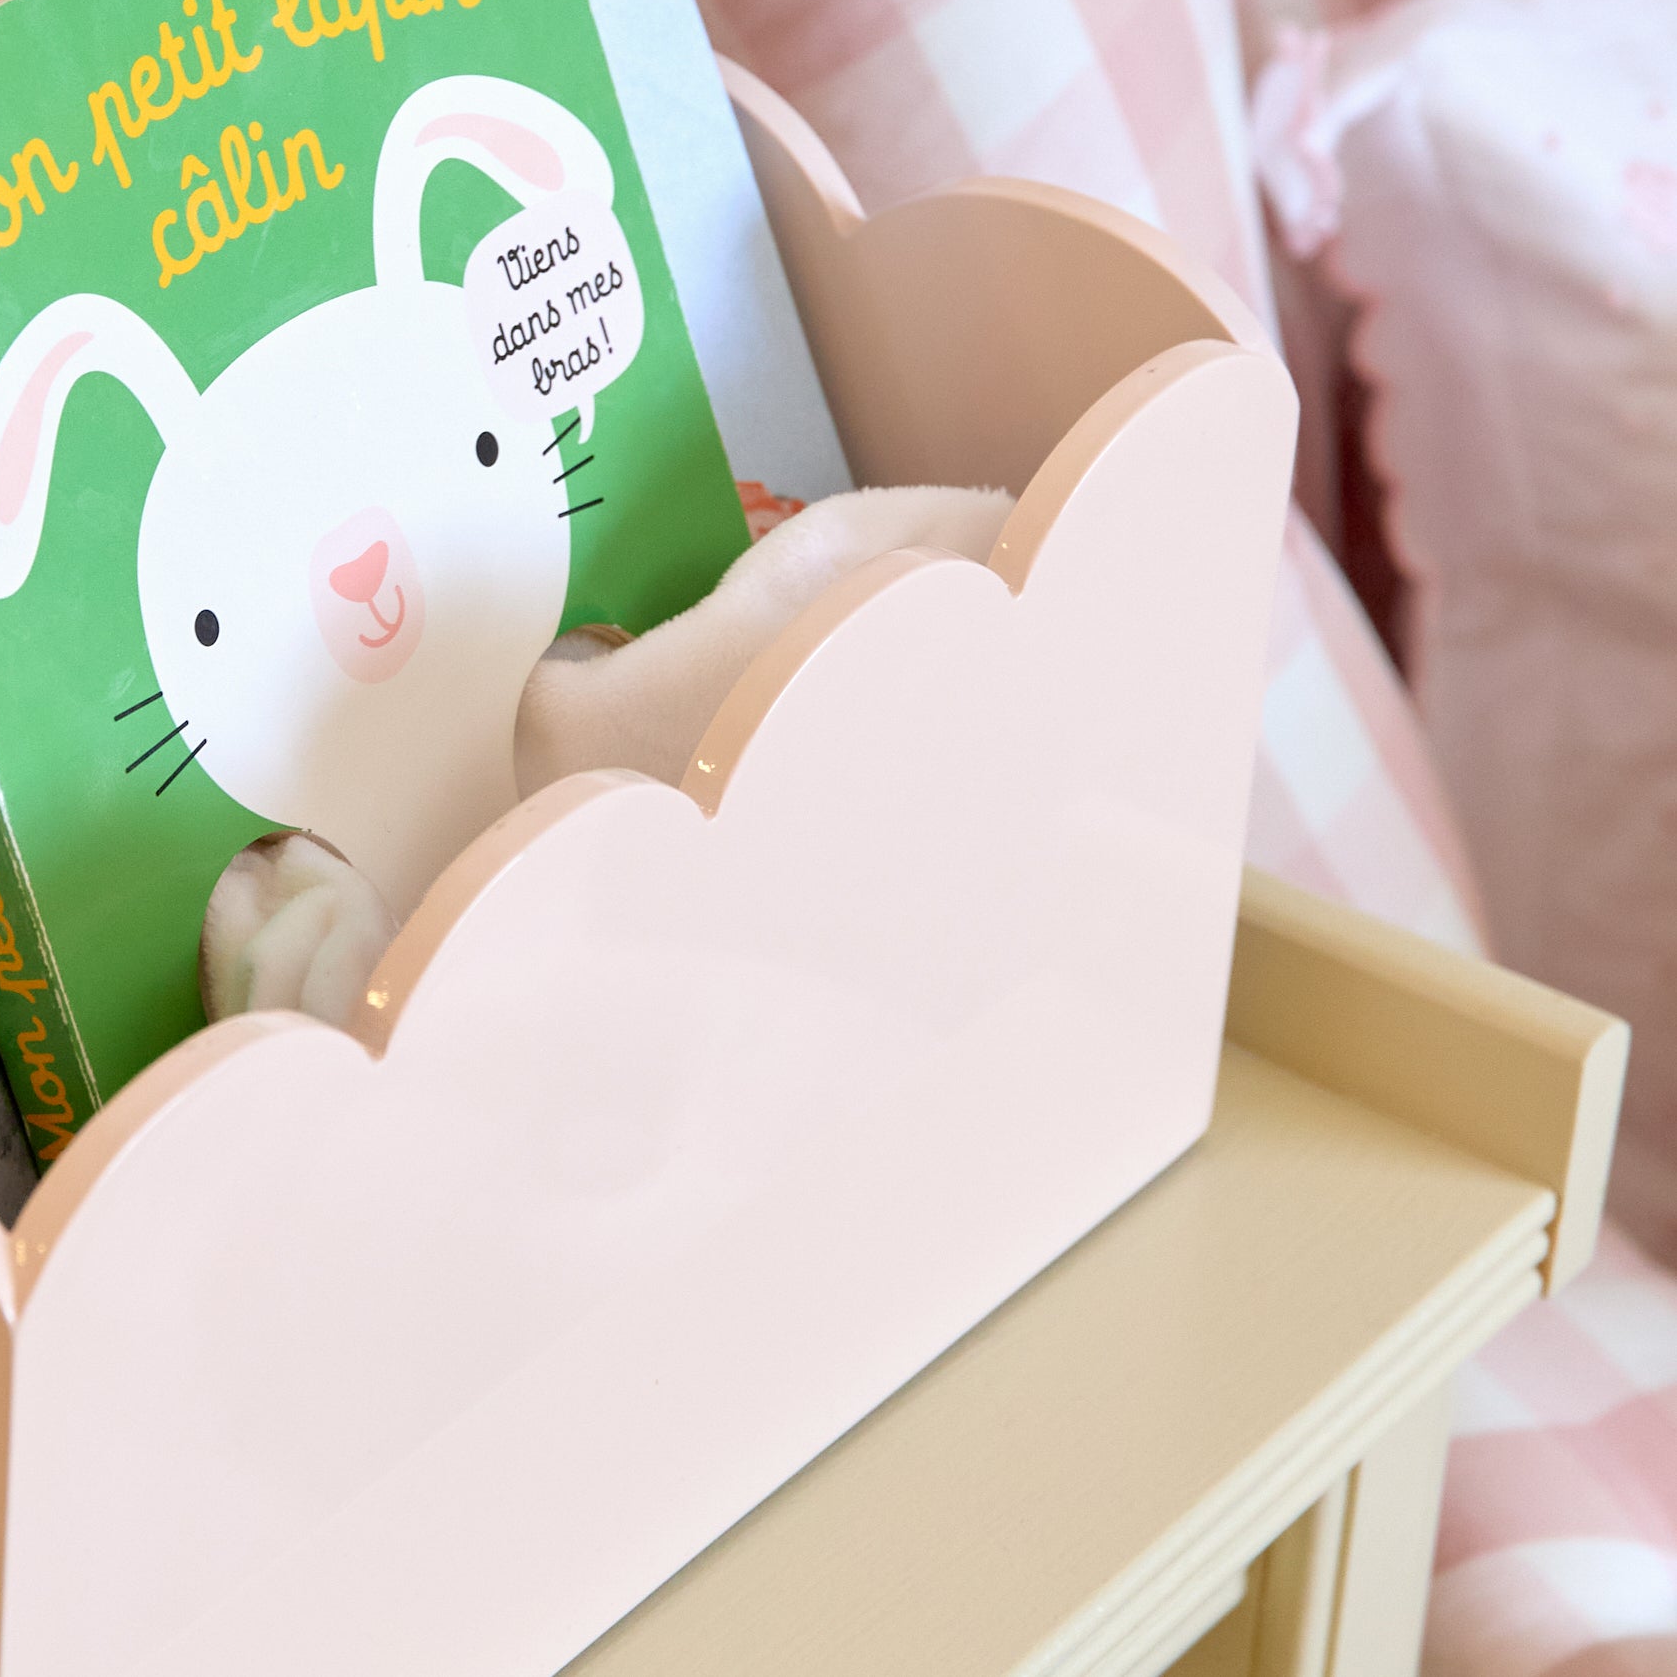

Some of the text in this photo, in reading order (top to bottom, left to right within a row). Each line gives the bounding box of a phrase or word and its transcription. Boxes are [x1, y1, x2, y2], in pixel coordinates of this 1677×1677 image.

[150, 119, 346, 290] câlin
[497, 226, 580, 291] Viens
[493, 261, 623, 365] dans mes
